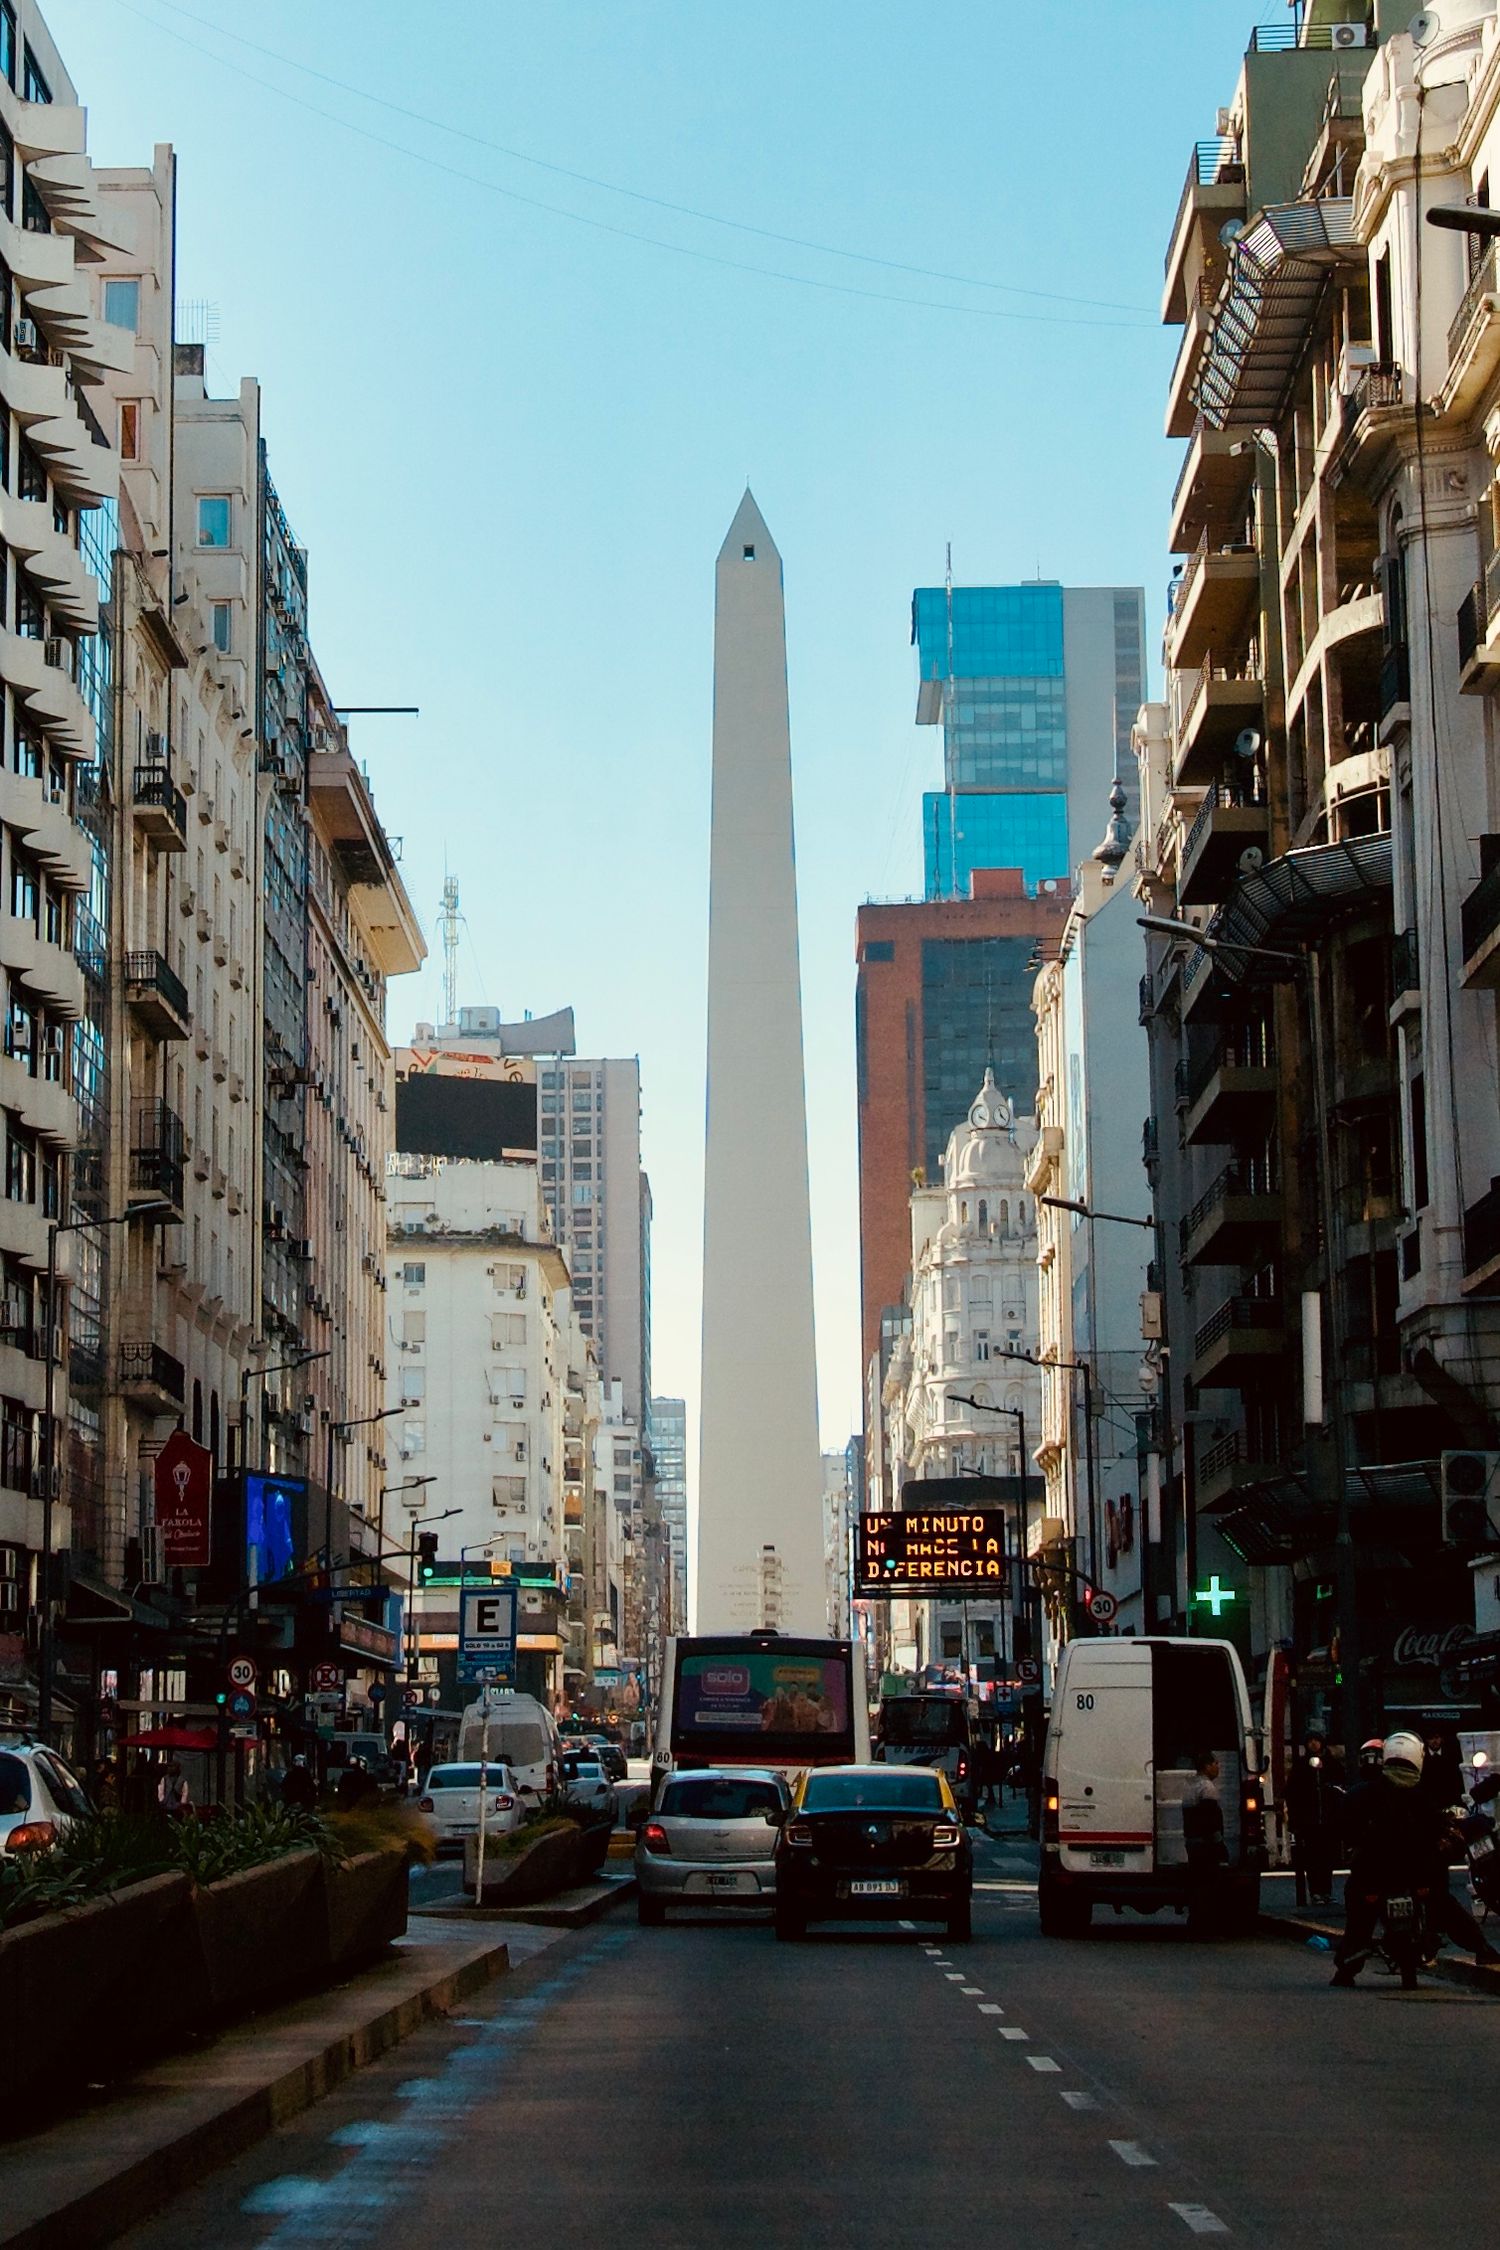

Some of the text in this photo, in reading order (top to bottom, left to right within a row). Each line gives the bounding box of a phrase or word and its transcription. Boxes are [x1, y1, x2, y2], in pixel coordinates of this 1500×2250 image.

[176, 1508, 189, 1516] LA
[906, 1516, 984, 1533] MINUTO
[906, 1538, 959, 1555] HACE
[331, 1588, 372, 1598] LIBERTAD
[1094, 1600, 1111, 1613] 30
[477, 1599, 500, 1633] E
[234, 1666, 250, 1678] 30
[707, 1670, 743, 1683] solo
[1076, 1694, 1094, 1710] 80
[656, 1752, 670, 1763] 60
